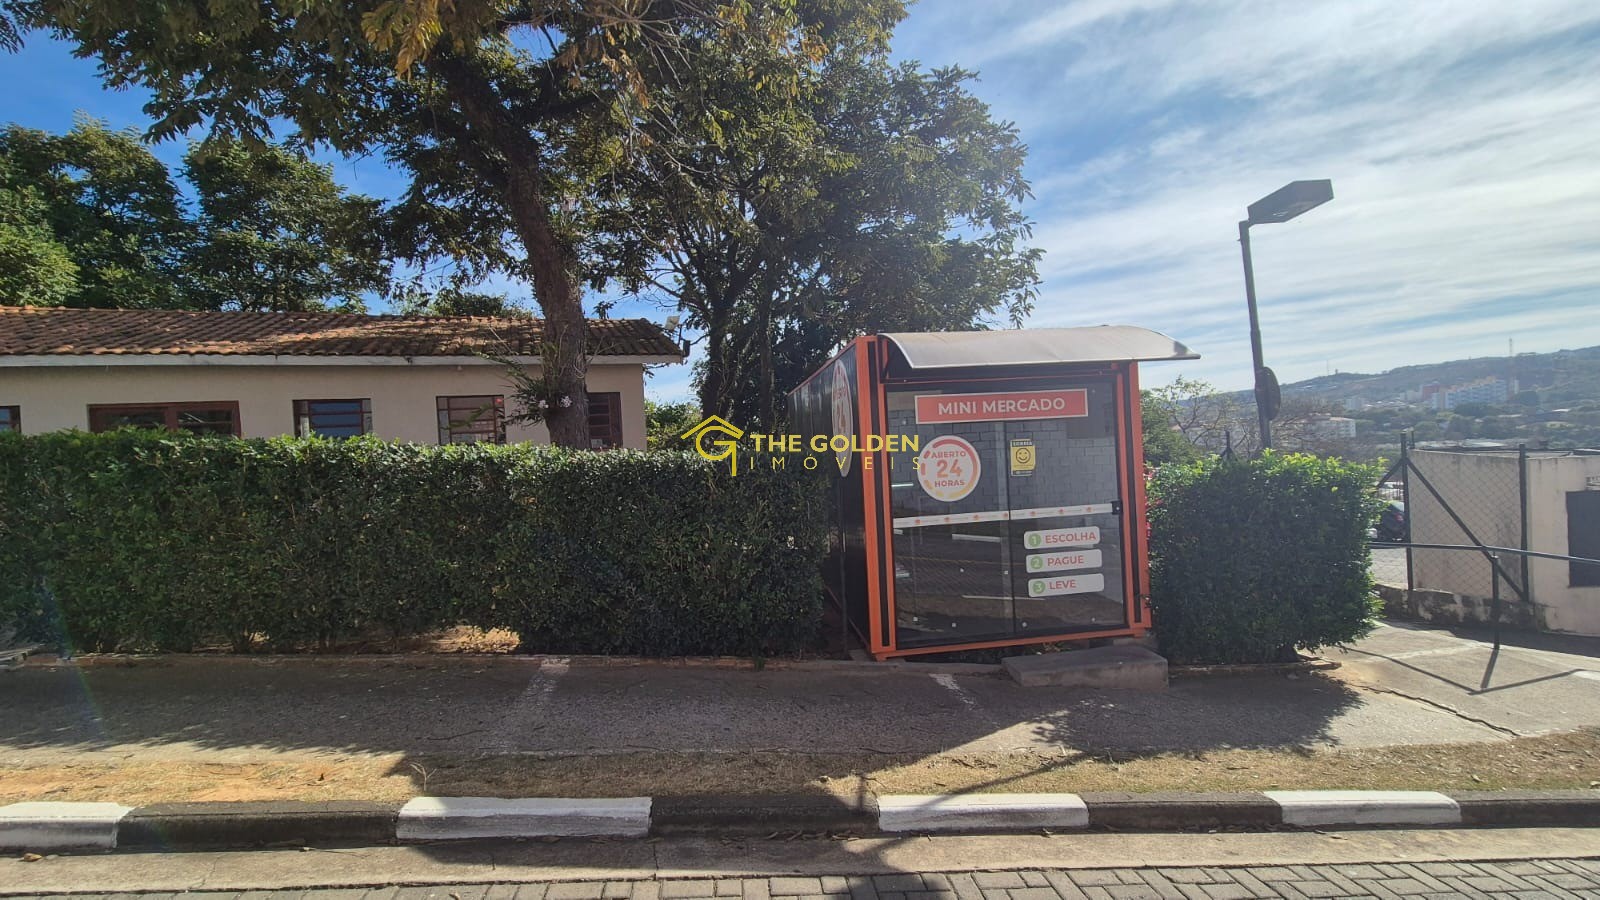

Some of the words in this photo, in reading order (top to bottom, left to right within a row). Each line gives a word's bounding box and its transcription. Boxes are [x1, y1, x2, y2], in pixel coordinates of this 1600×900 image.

[938, 400, 977, 416] MINI
[982, 397, 1066, 414] MERCADO
[931, 450, 967, 459] ABERTO
[936, 459, 963, 478] 24
[934, 479, 966, 489] HORAS
[1044, 531, 1097, 544] ESCOLHA
[1032, 558, 1041, 567] 2
[1047, 555, 1085, 567] PAGUE
[1035, 582, 1043, 592] 3
[1049, 579, 1077, 590] LEVE
